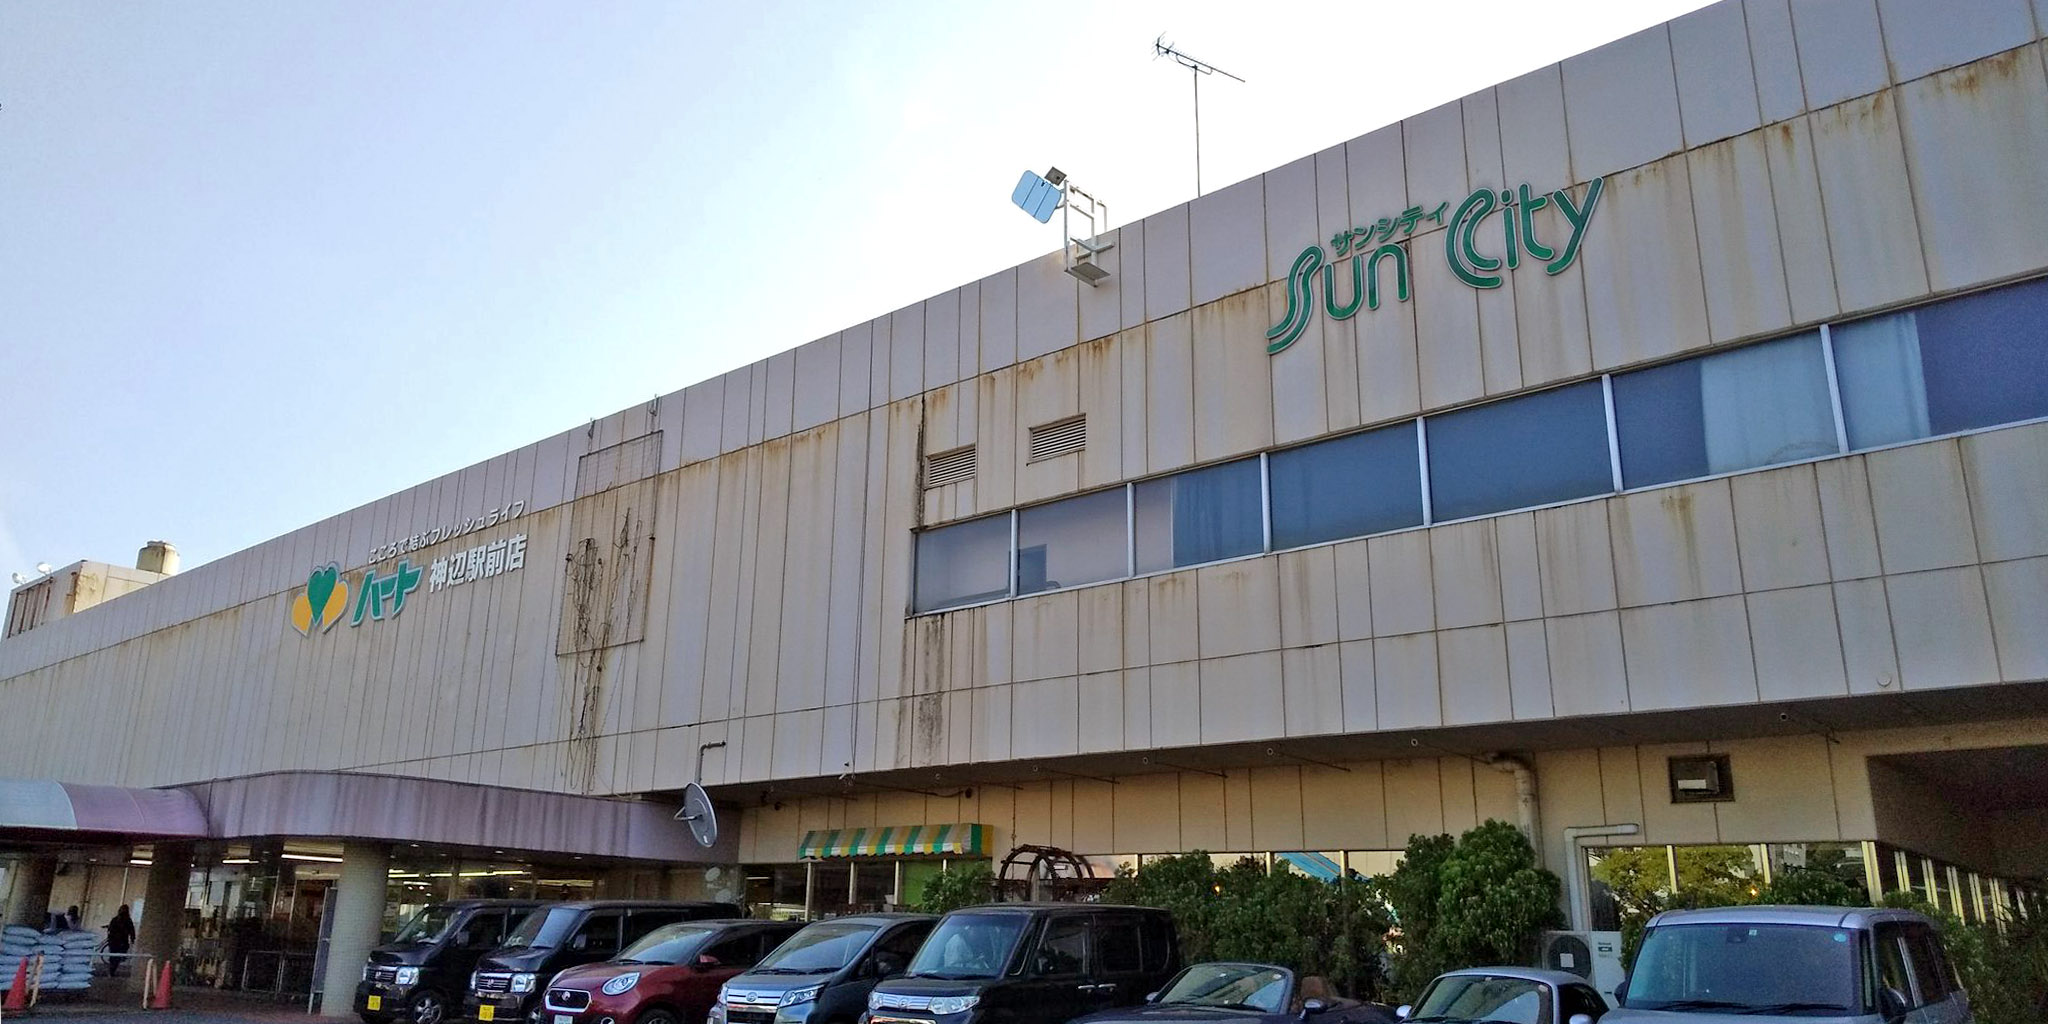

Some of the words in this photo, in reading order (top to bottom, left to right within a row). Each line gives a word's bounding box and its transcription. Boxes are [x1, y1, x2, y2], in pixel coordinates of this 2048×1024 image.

[1265, 246, 1410, 355] Sun
[1445, 176, 1604, 289] City
[1330, 201, 1449, 257] サンシティ
[368, 500, 526, 565] こころで結ぶフレッシュライフ
[350, 558, 424, 627] ハート
[428, 533, 528, 593] 神辺駅前店
